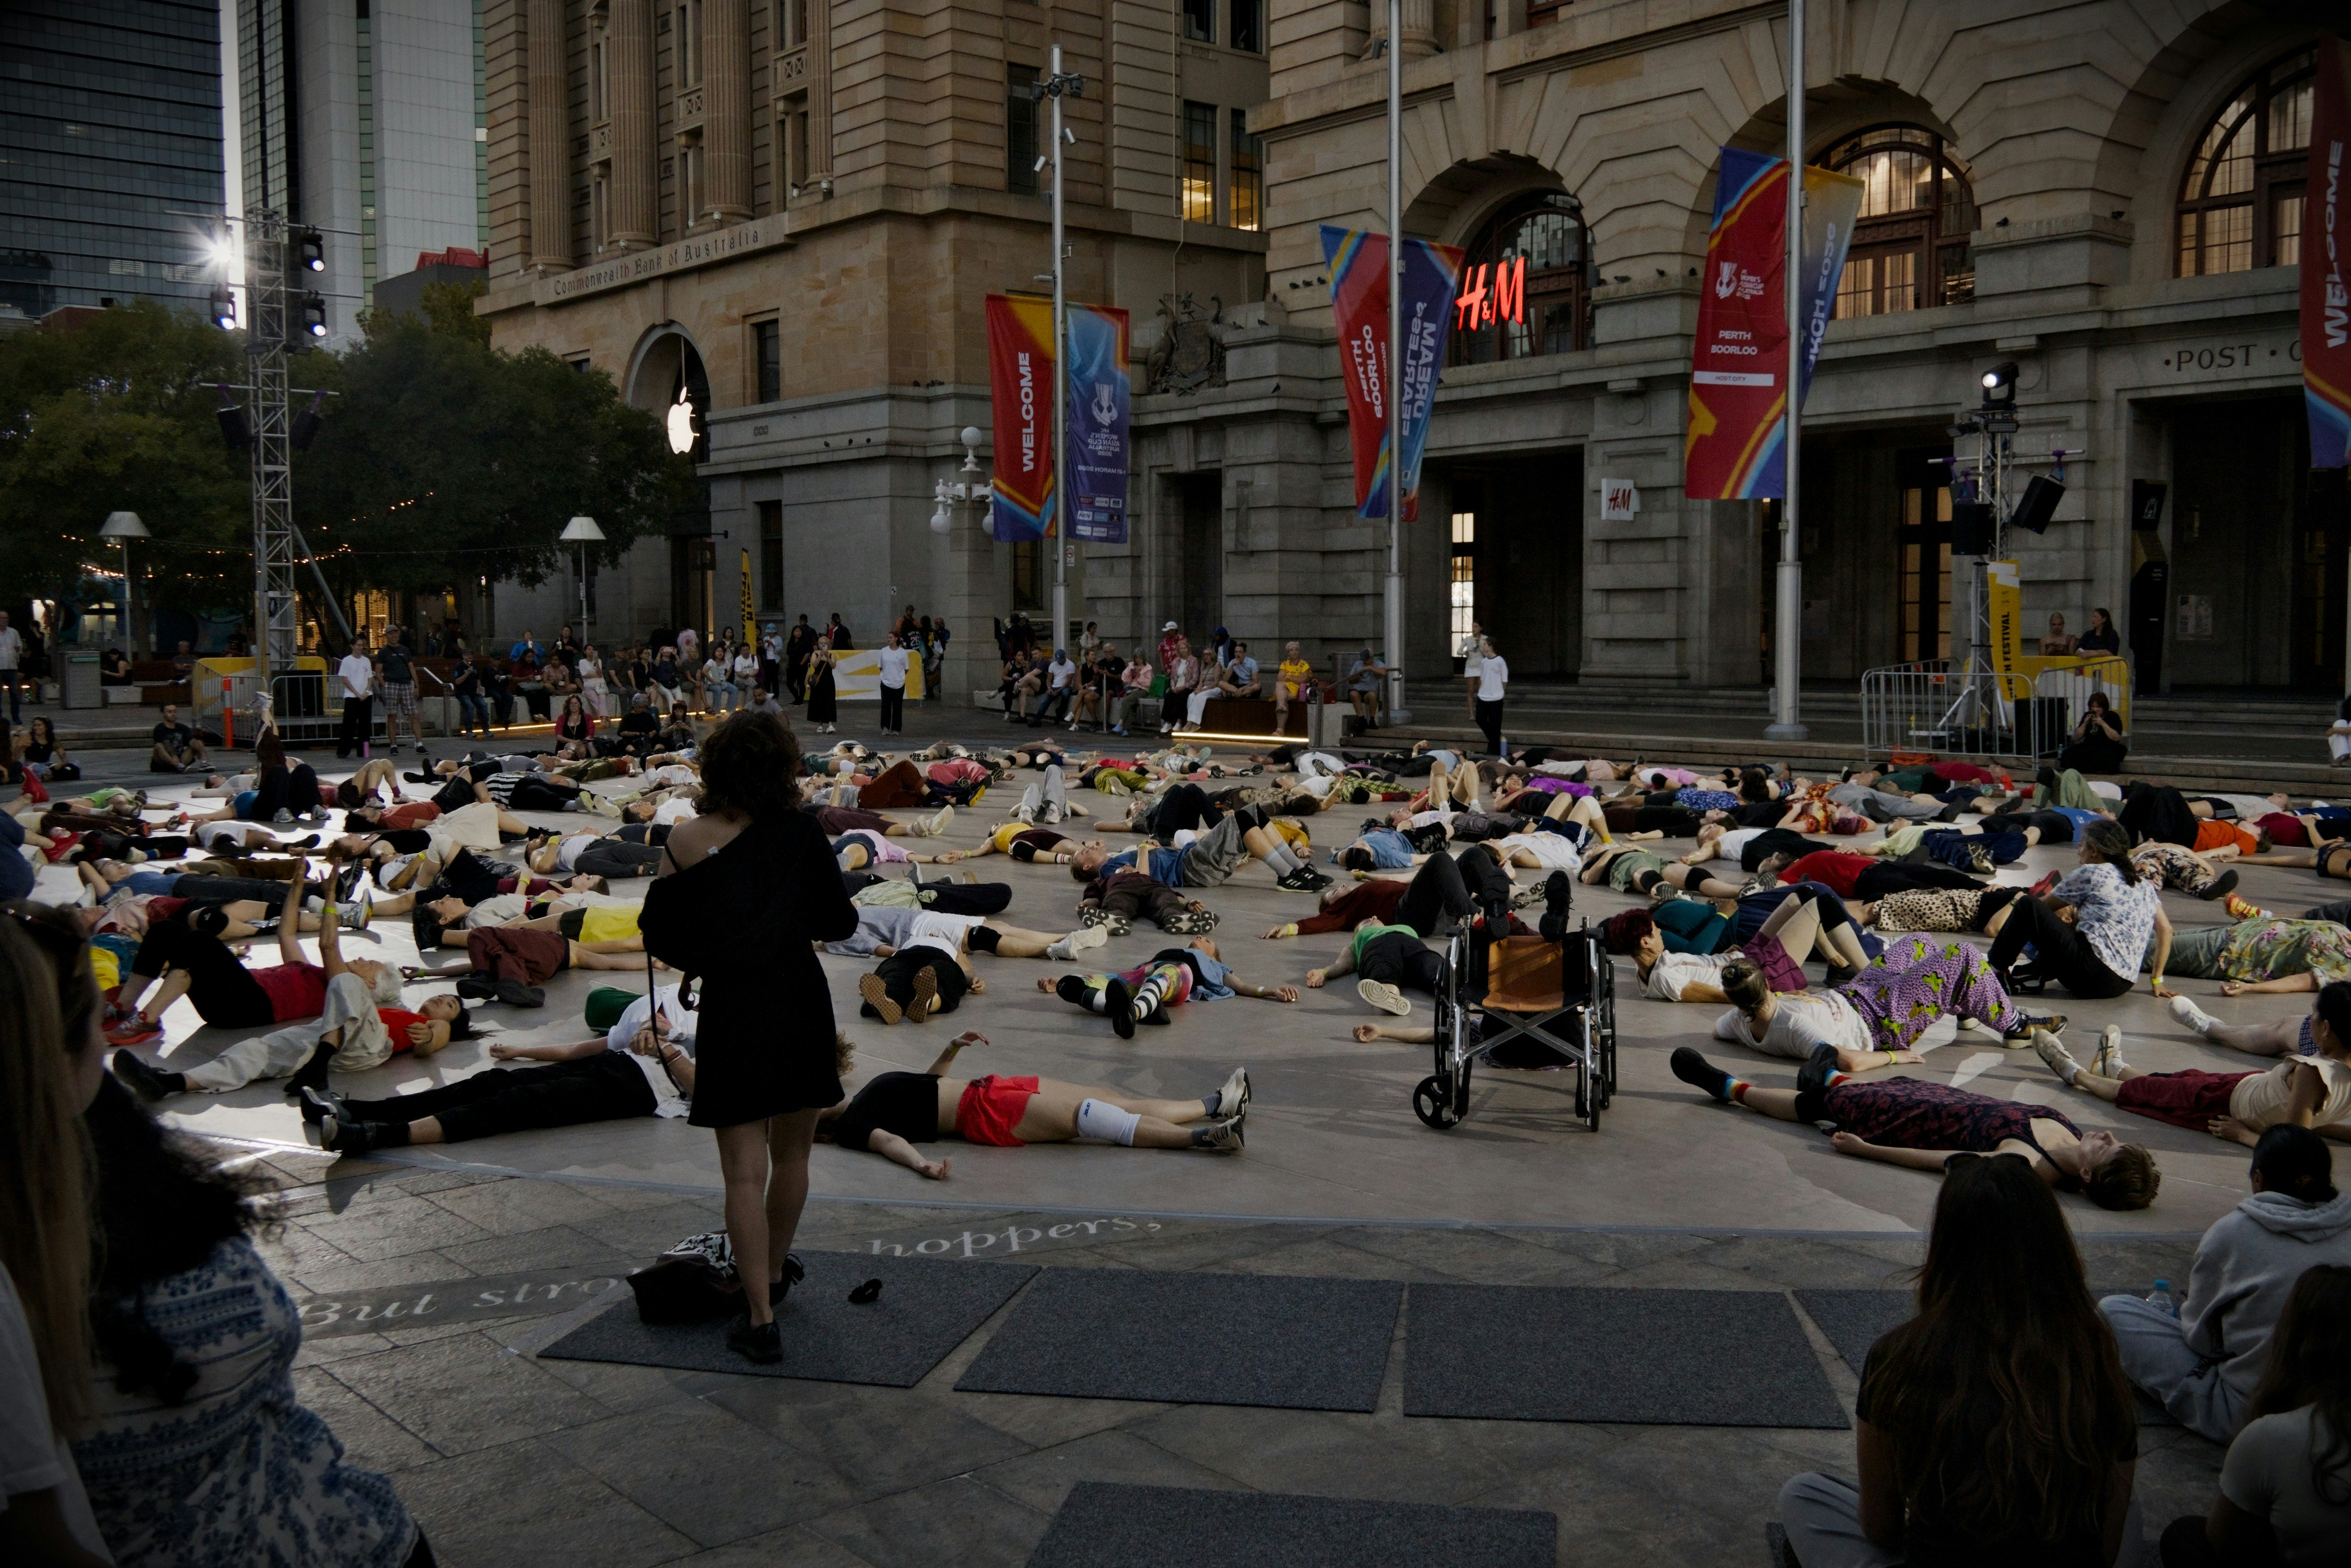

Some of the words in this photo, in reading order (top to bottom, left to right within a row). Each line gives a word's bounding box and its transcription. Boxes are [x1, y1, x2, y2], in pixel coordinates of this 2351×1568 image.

[554, 263, 629, 295] Commonwealth
[634, 254, 662, 276] Bank
[668, 249, 678, 265] of
[684, 230, 759, 263] Australia
[2324, 140, 2349, 348] WELCOME
[1455, 256, 1525, 332] H&M
[1710, 345, 1758, 355] BOORLOO
[1719, 330, 1752, 340] PERTH
[2177, 344, 2257, 371] POST
[1351, 340, 1371, 402] PERTH
[1362, 324, 1382, 418] BOORLOO
[1018, 352, 1035, 473] WELCOME
[1609, 488, 1632, 511] H&M
[2001, 612, 2011, 661] FESTIVAL
[295, 1292, 439, 1327] But
[842, 1216, 1162, 1258] hoppers,
